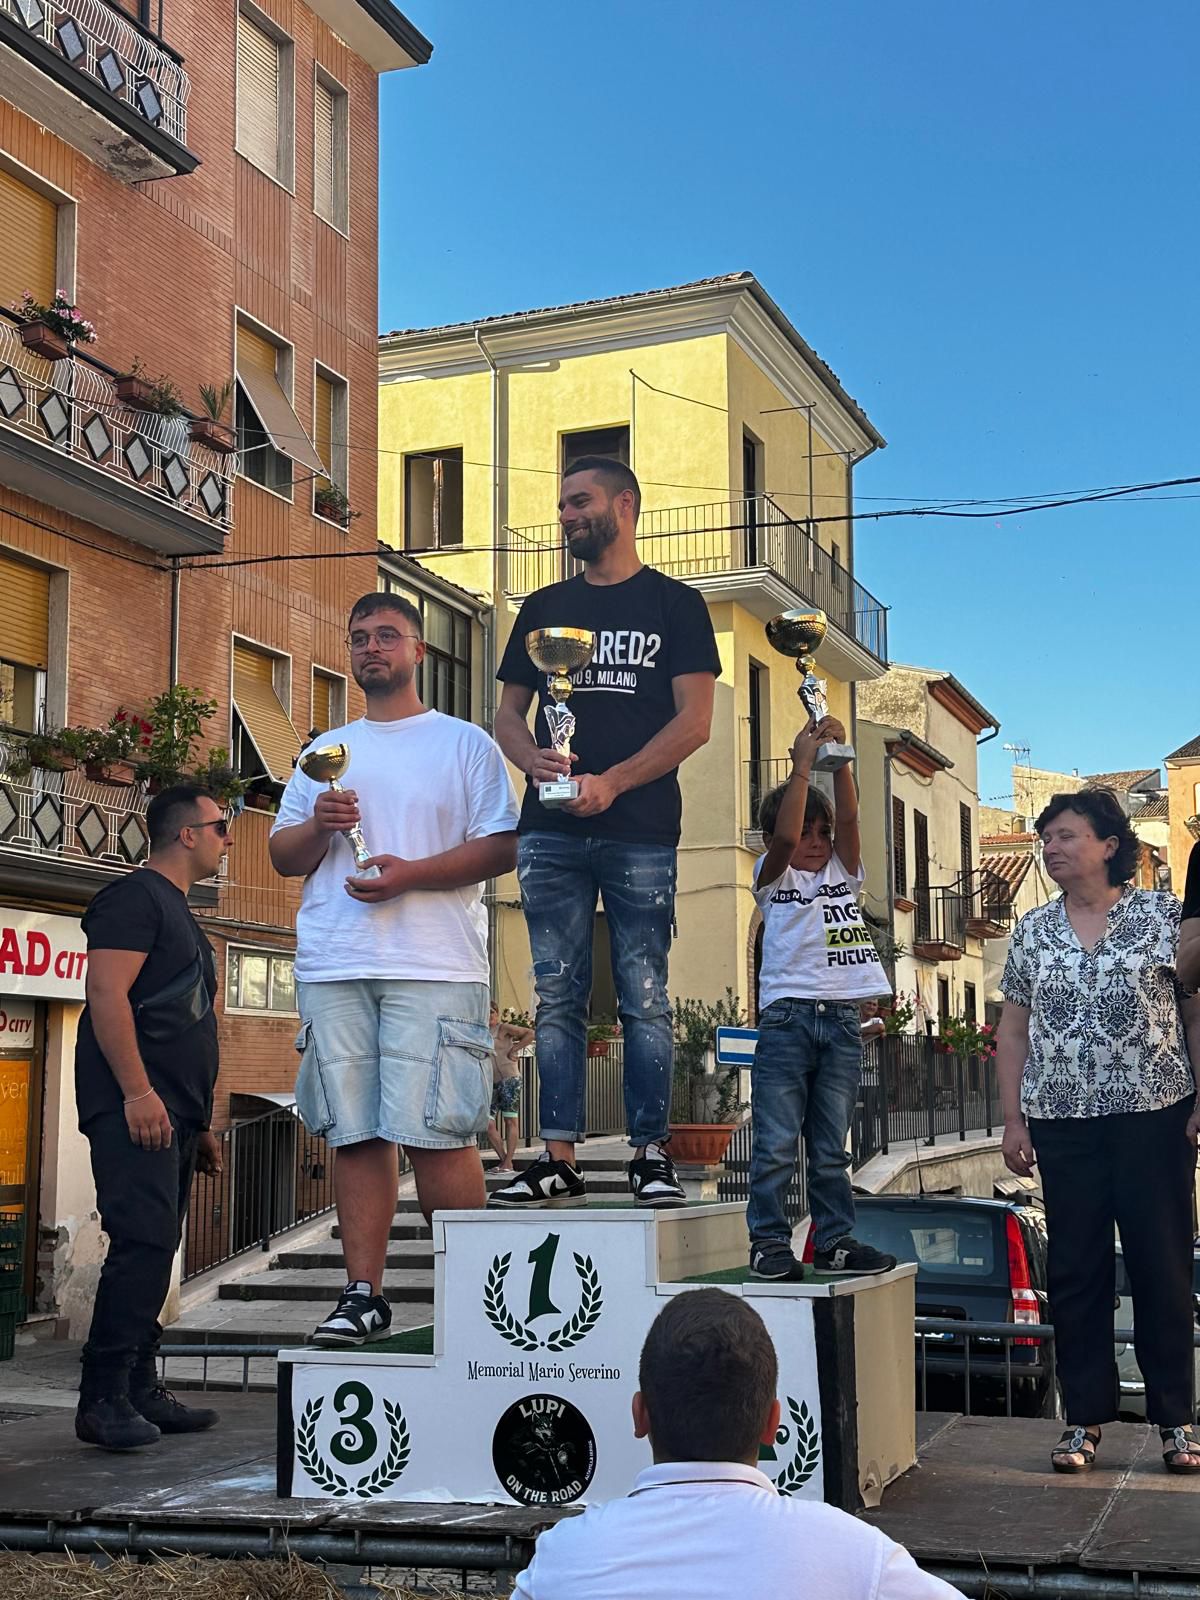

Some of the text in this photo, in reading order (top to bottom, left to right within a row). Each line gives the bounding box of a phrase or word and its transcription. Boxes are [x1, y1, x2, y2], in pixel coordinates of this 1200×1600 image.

[597, 670, 637, 688] MILANO
[8, 1018, 32, 1033] CITY
[524, 1232, 561, 1325] 1
[467, 1361, 621, 1382] Memorial Mario Severino
[518, 1398, 567, 1419] LUPI
[329, 1380, 378, 1465] 3
[506, 1474, 583, 1503] ON THE ROAD
